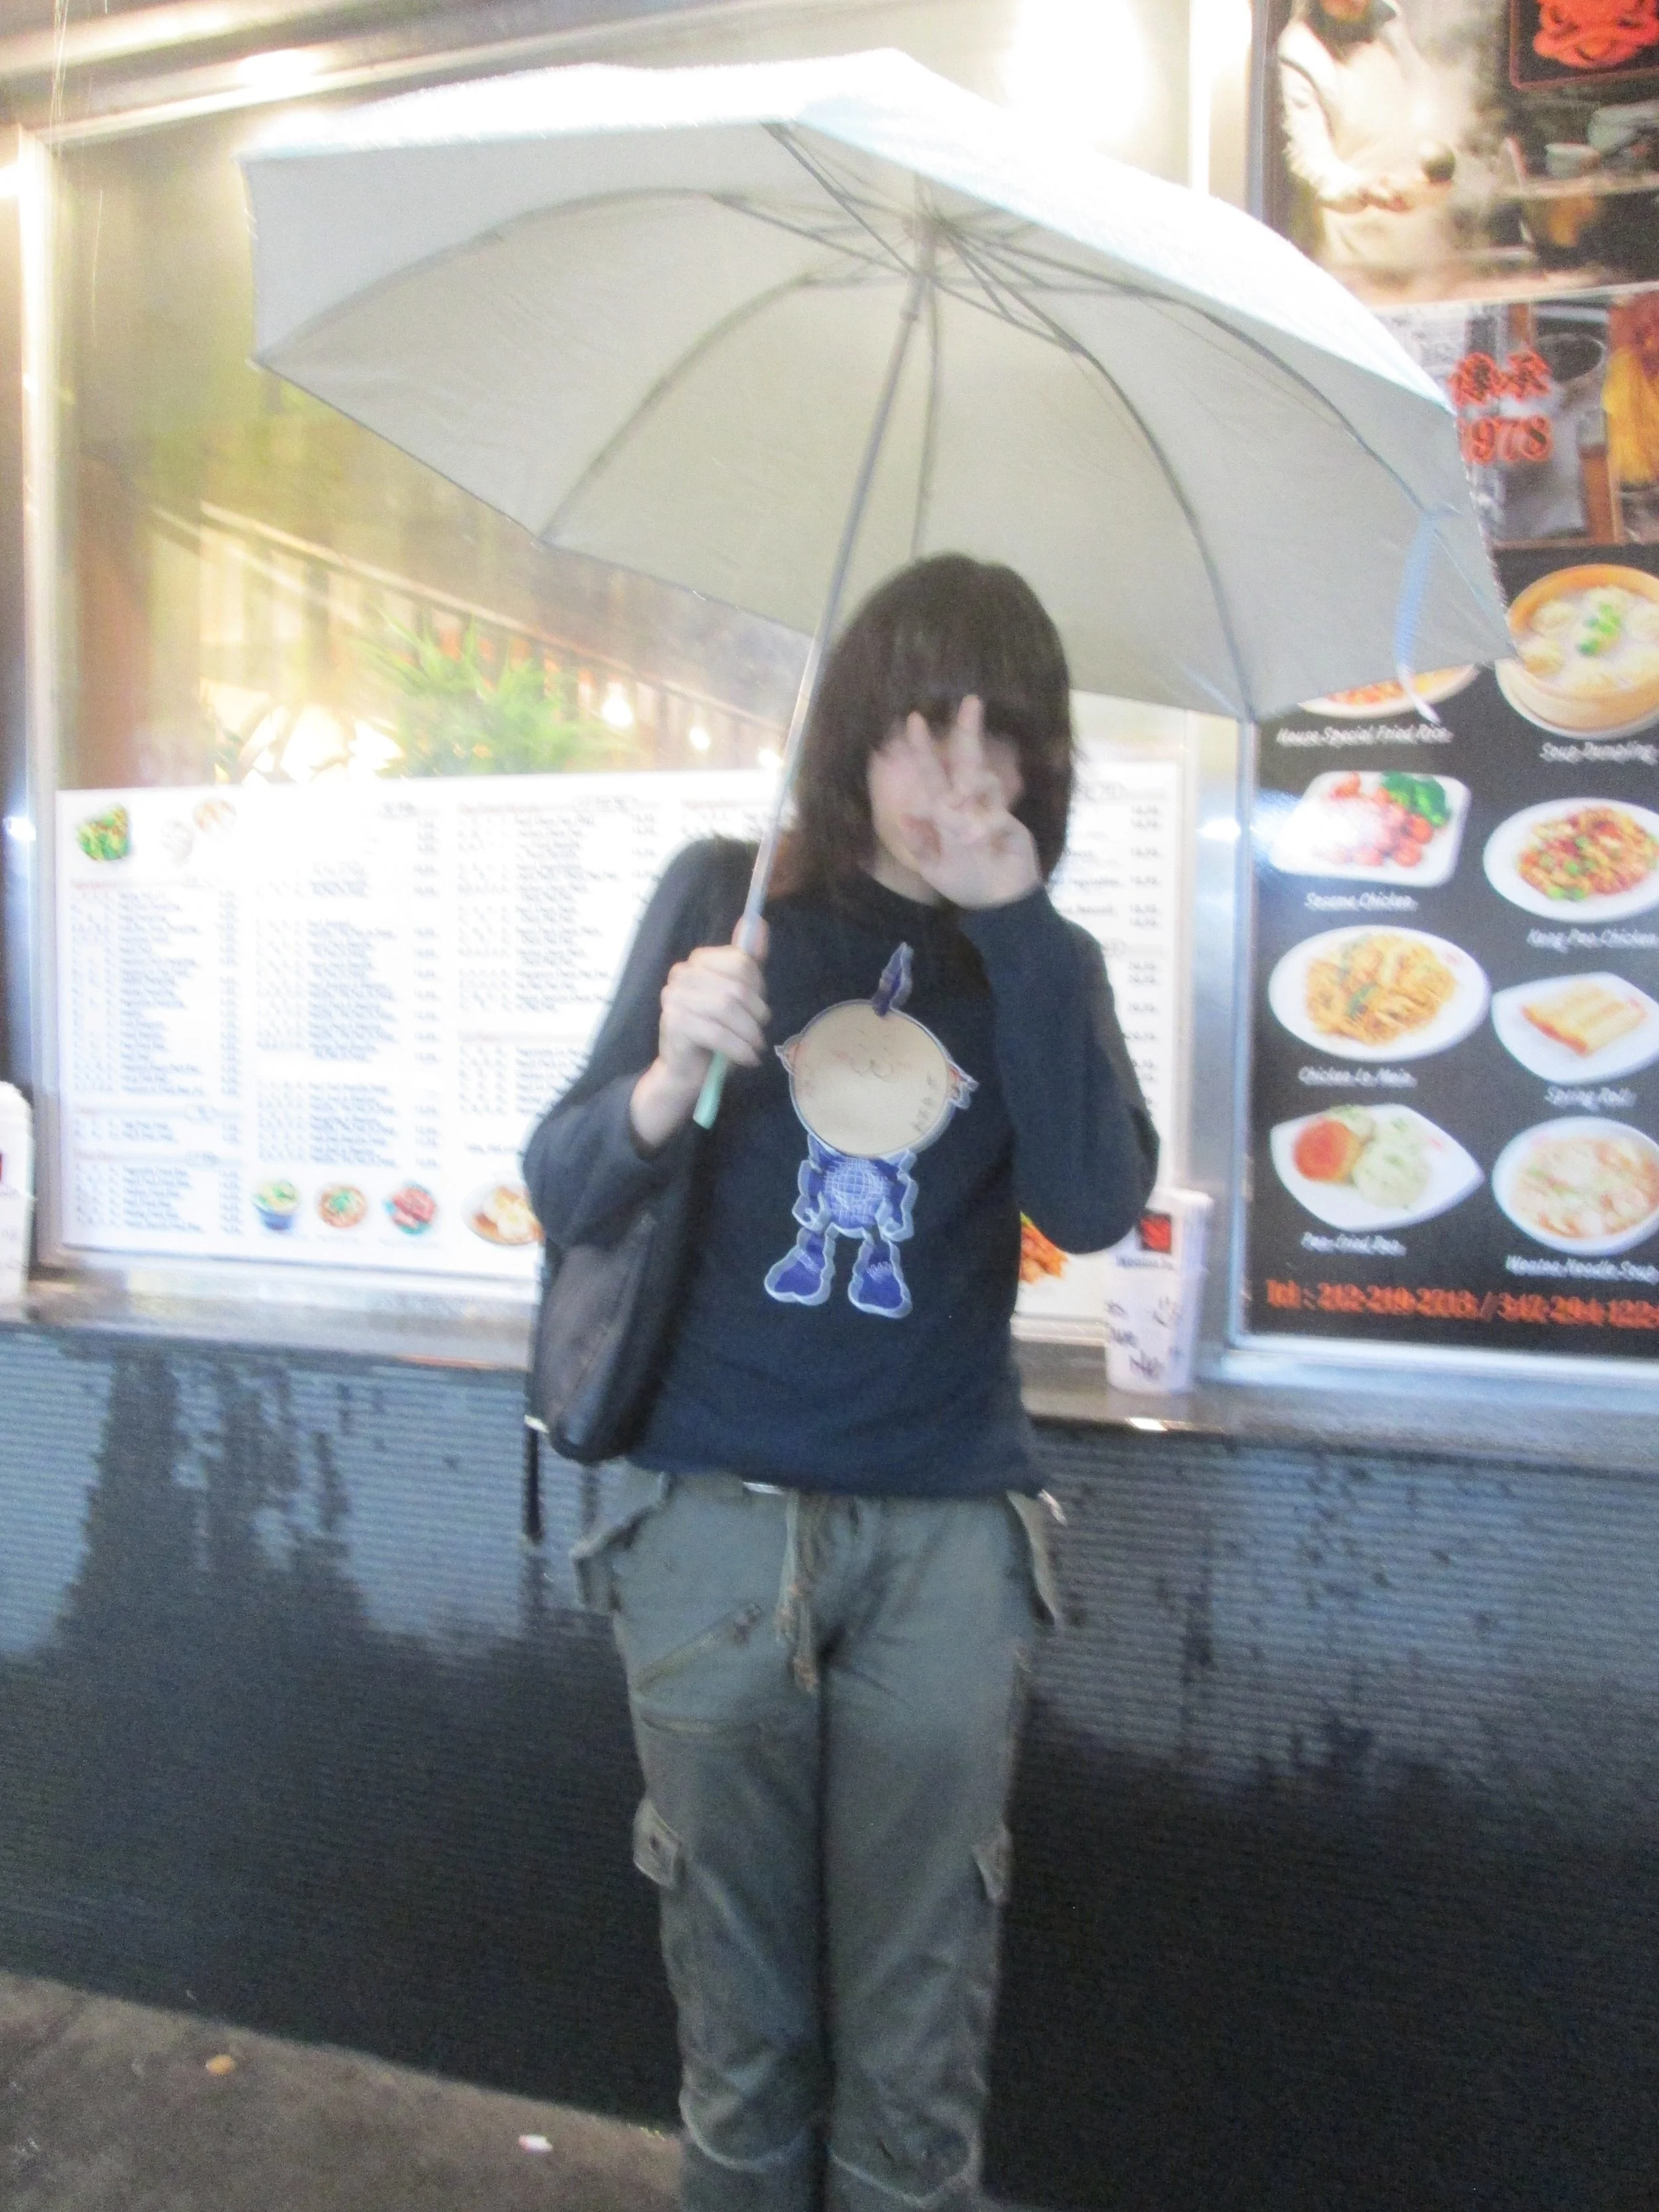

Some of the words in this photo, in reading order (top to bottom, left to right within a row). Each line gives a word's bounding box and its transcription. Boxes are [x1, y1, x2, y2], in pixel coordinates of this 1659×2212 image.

[1276, 728, 1323, 747] House
[1321, 725, 1376, 749] Special
[1376, 725, 1418, 744] Fried
[1416, 723, 1454, 744] Rice
[1540, 742, 1583, 764] Soup
[1305, 892, 1360, 911] Sesame
[1360, 892, 1418, 911] Chicken
[1527, 928, 1567, 953] Kung
[1567, 928, 1601, 948] Pao
[1298, 1066, 1356, 1086] Chicken
[1354, 1067, 1378, 1086] Lo
[1544, 1086, 1598, 1112] Spring
[1505, 1255, 1567, 1278] Wonton
[1567, 1258, 1622, 1280] Noodle
